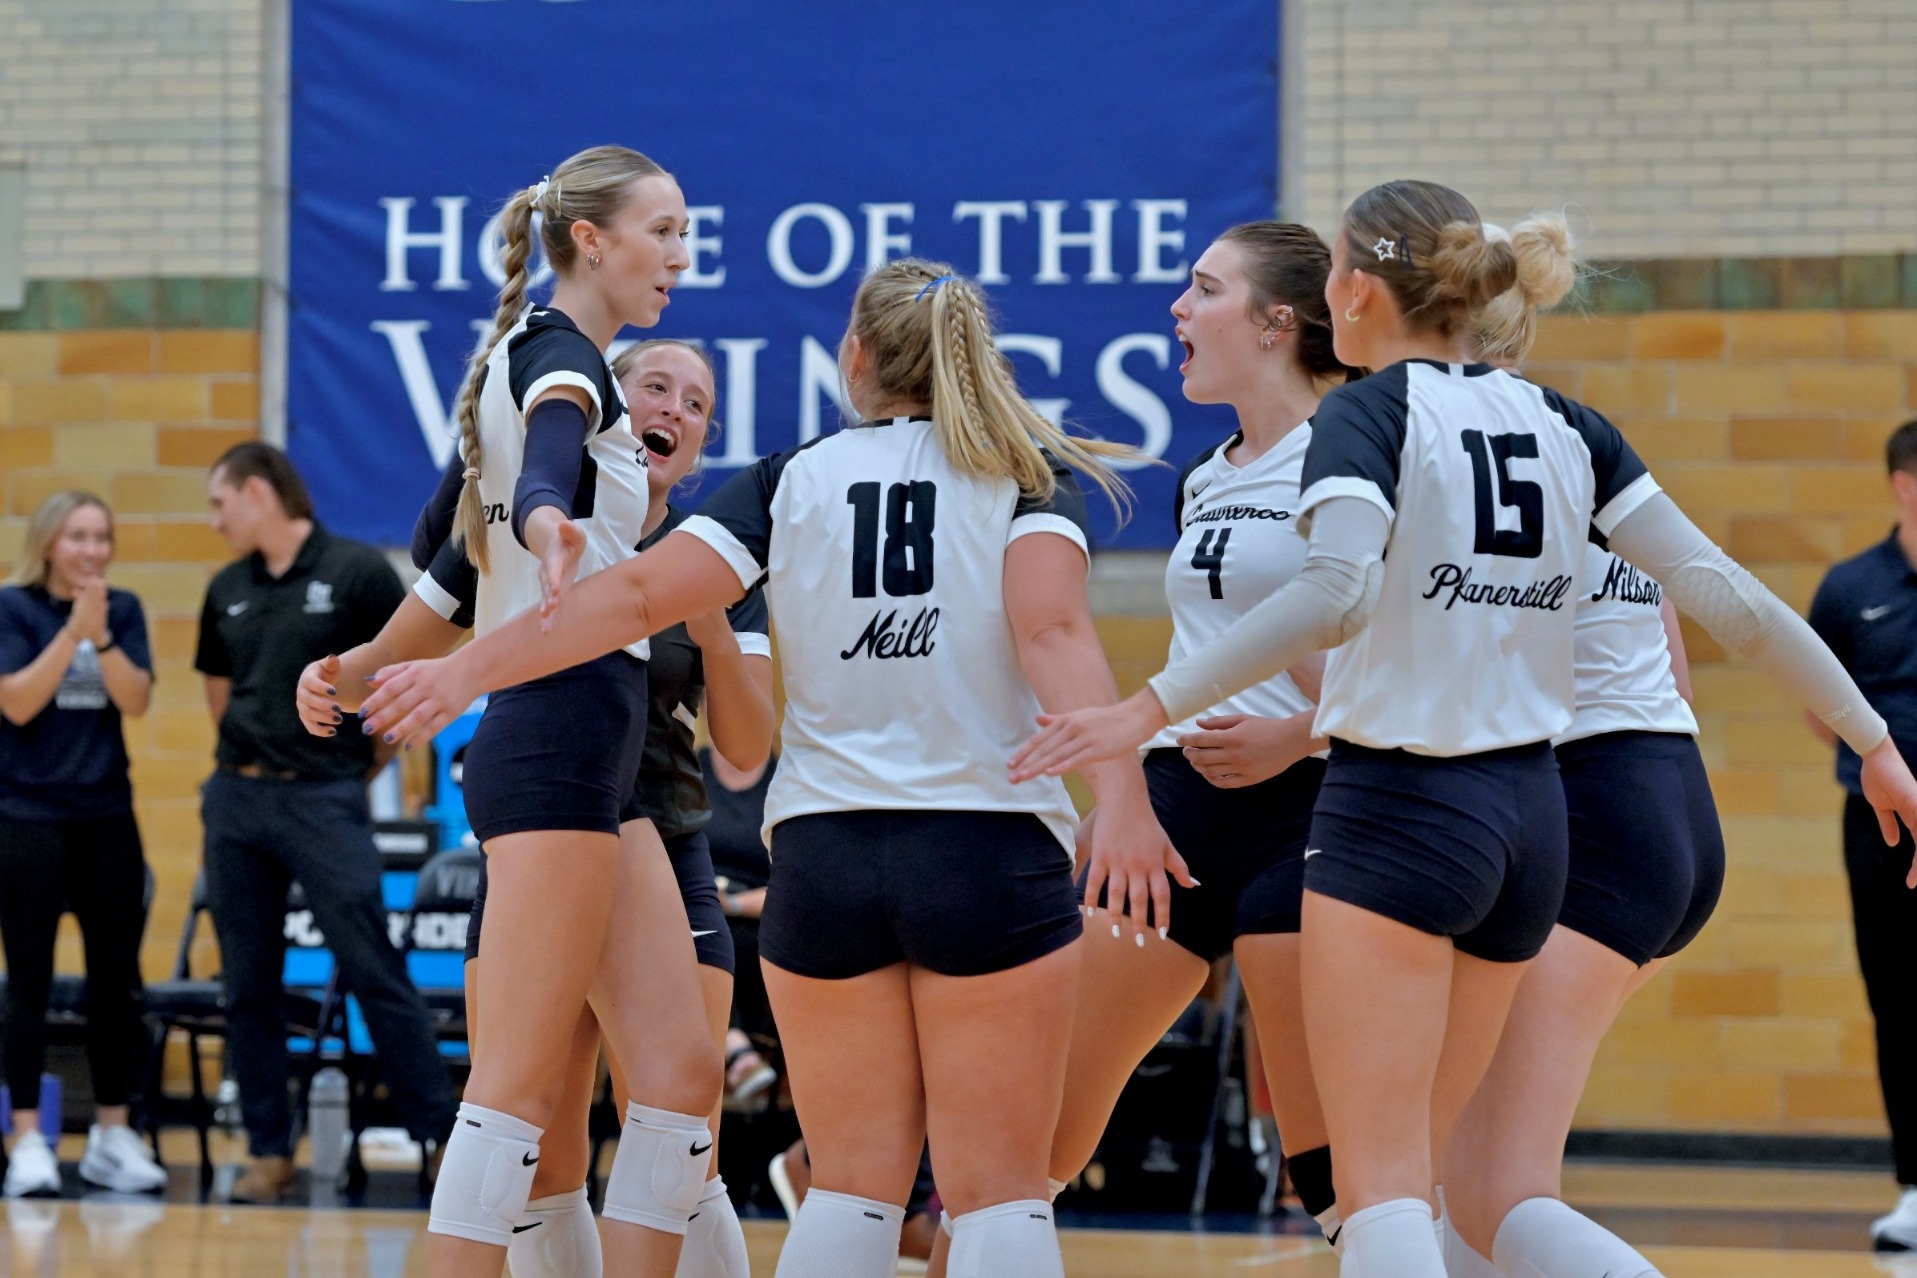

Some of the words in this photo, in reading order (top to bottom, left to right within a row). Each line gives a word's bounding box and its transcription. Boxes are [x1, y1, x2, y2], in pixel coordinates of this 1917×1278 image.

[379, 196, 726, 292] HOE
[766, 202, 915, 289] OF
[953, 199, 1189, 285] THE
[1460, 428, 1544, 559] 15
[847, 480, 937, 598] 18
[1191, 528, 1232, 599] 4
[1423, 563, 1572, 611] Pfanerstill
[840, 606, 940, 660] Neill
